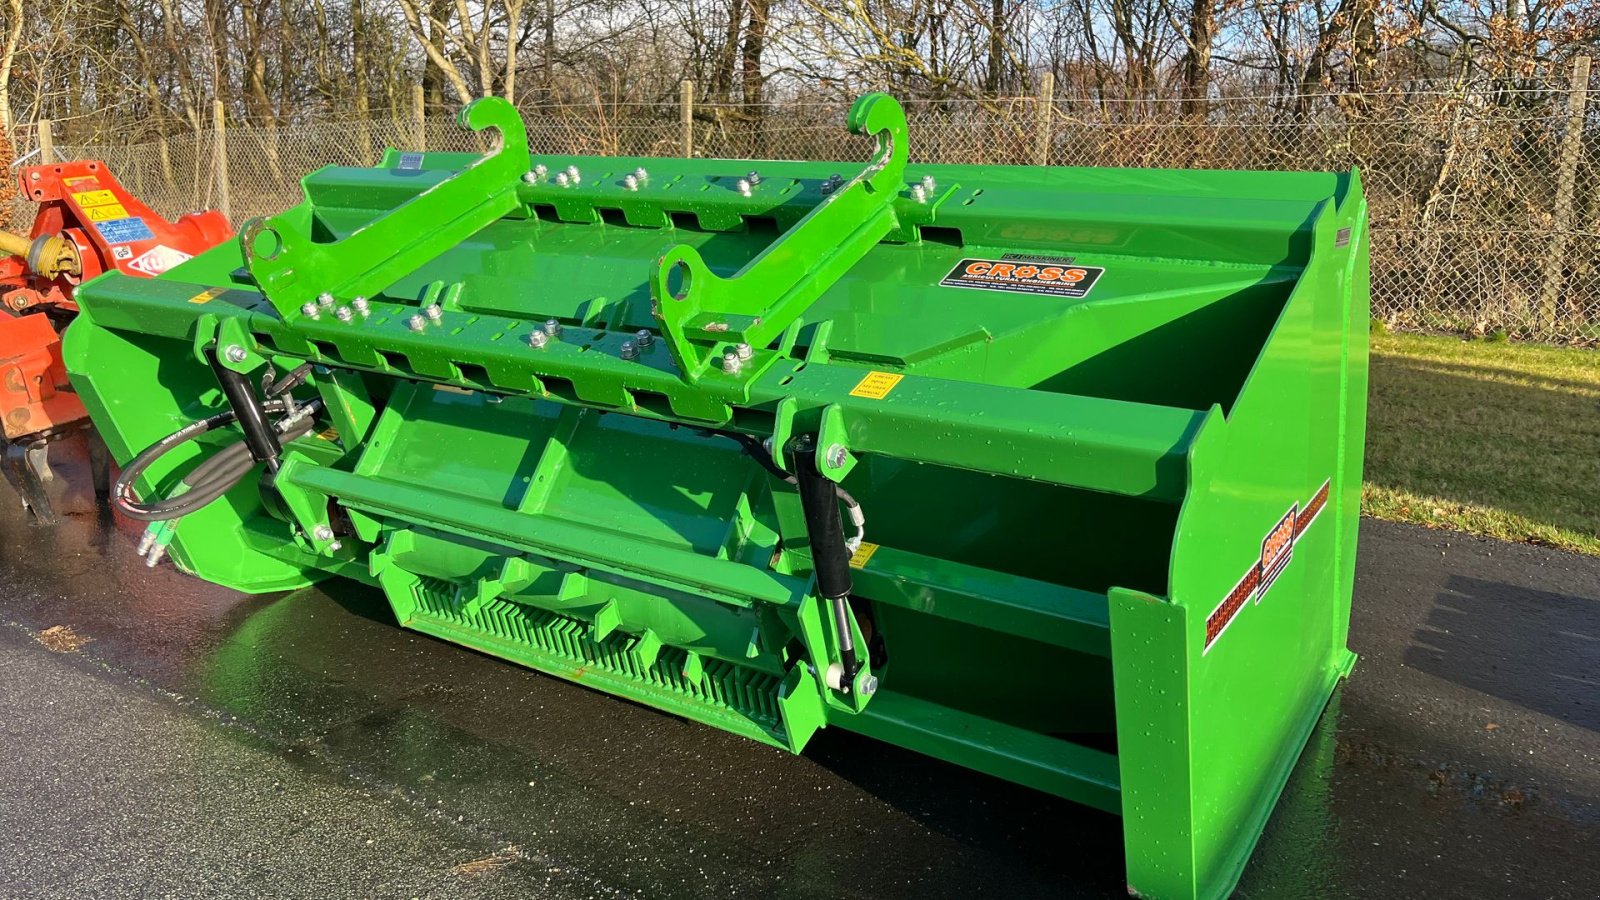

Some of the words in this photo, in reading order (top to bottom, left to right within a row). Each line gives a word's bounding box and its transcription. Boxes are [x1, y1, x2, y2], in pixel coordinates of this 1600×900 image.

[962, 273, 1020, 283] AGRICULTURAL
[1021, 277, 1076, 287] ENGINEERING
[965, 262, 1088, 283] CROSS
